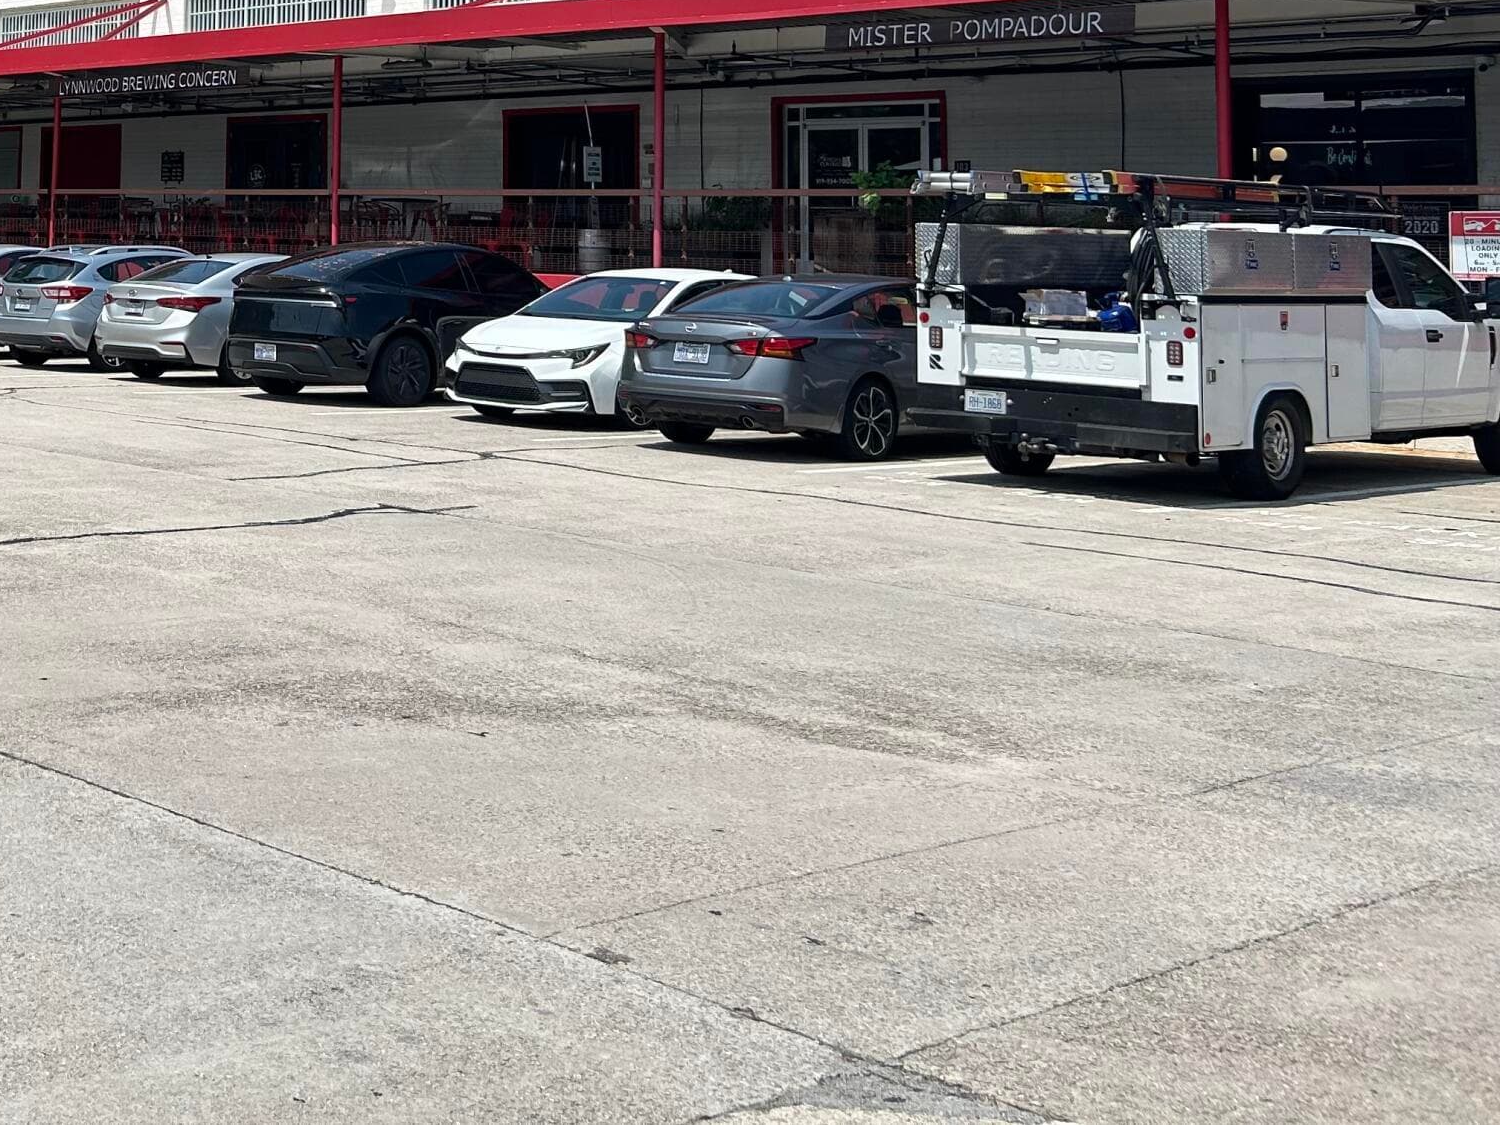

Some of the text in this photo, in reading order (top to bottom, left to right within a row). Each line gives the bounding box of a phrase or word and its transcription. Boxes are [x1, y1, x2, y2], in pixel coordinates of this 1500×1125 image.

[849, 11, 1104, 47] MISTER POMPADOUR
[59, 69, 237, 96] LYNNWOOD BREWING CONCERN
[1404, 220, 1440, 234] 2020
